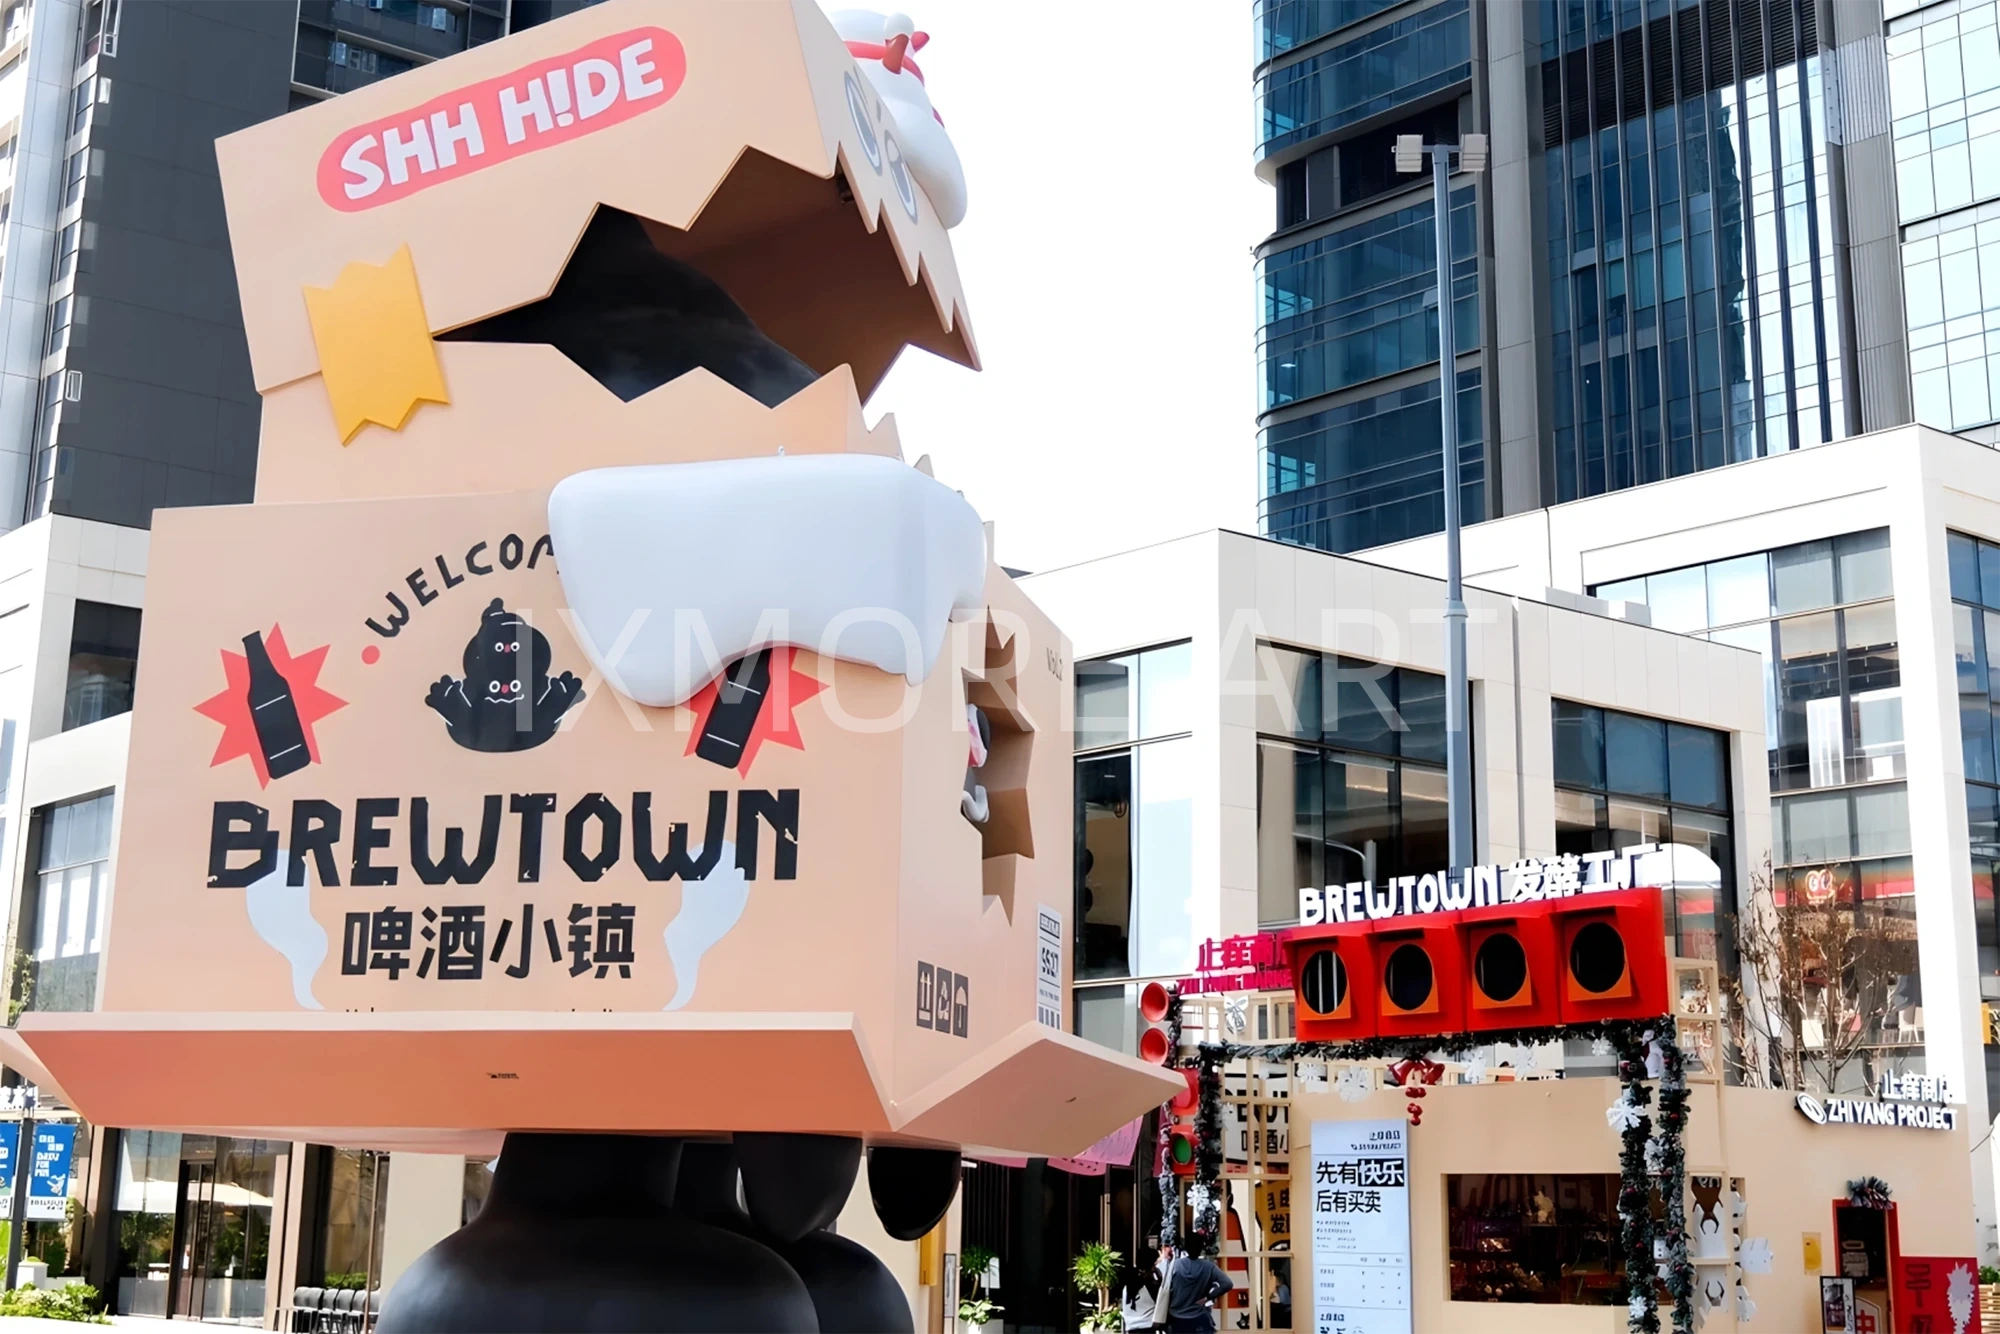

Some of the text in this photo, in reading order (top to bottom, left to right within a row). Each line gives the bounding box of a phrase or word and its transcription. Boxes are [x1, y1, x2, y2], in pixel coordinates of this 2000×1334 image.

[340, 102, 485, 200] SHH
[207, 788, 801, 889] BREWTOWN
[1299, 843, 1658, 926] BREWTOWN 发酵工厂
[341, 903, 636, 981] 啤酒小镇
[1897, 1105, 1958, 1131] PROJECT
[1316, 1159, 1404, 1187] 先有快乐
[1316, 1189, 1382, 1213] 后有买卖
